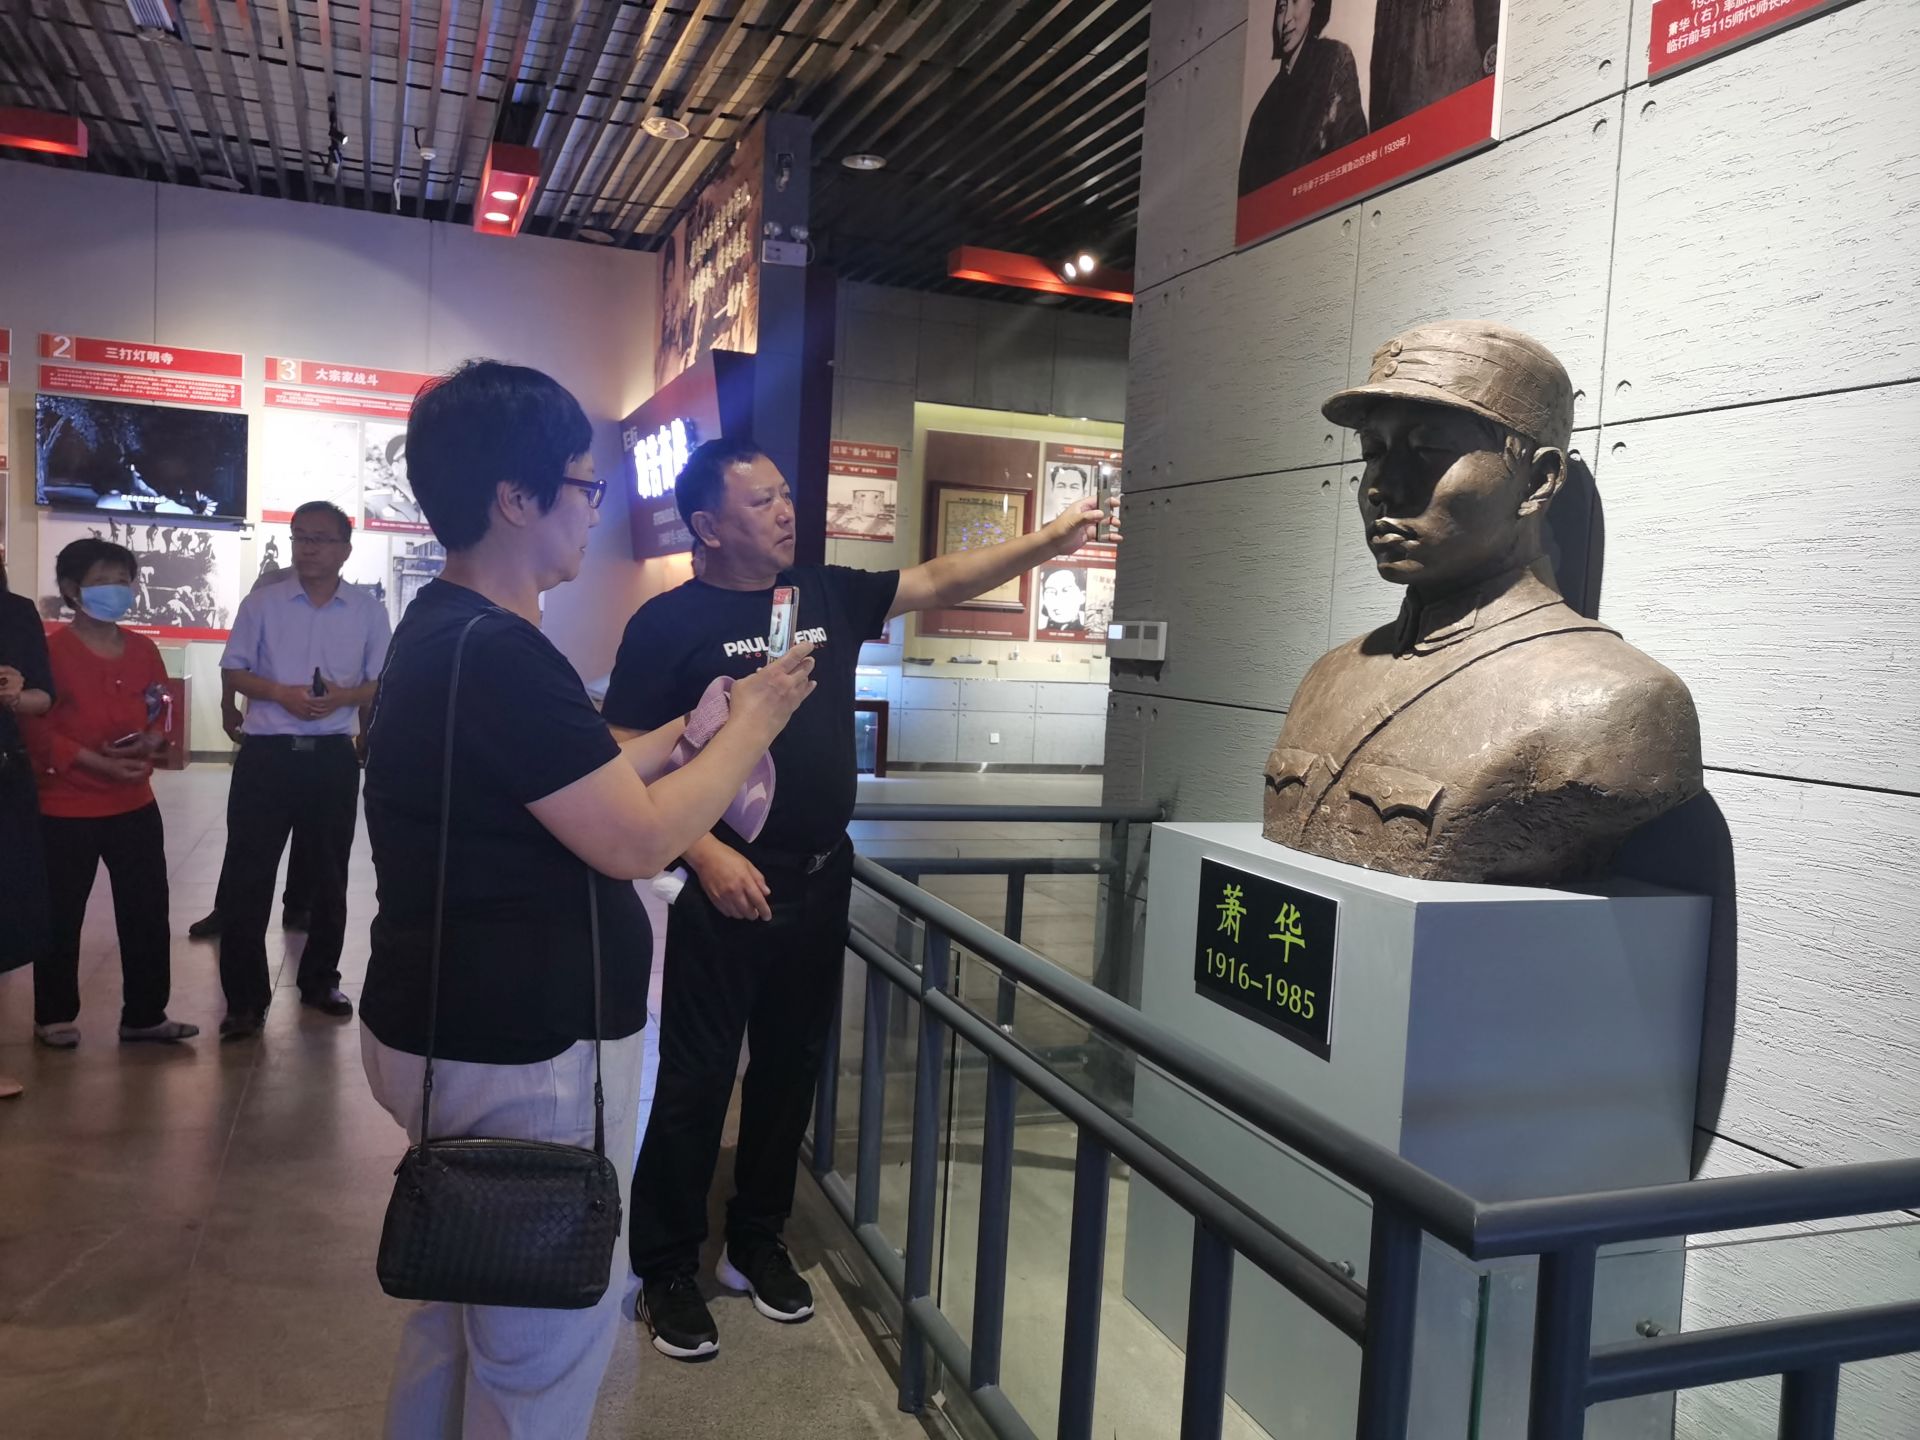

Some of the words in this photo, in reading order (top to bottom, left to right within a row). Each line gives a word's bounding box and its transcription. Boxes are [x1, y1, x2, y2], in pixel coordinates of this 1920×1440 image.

[53, 335, 71, 359] 2
[104, 347, 174, 365] 三打灯明寺
[280, 359, 297, 381] 3
[316, 368, 379, 387] 大宗家战斗
[1216, 883, 1306, 964] 萧华
[1206, 947, 1316, 1020] 1916-1985
